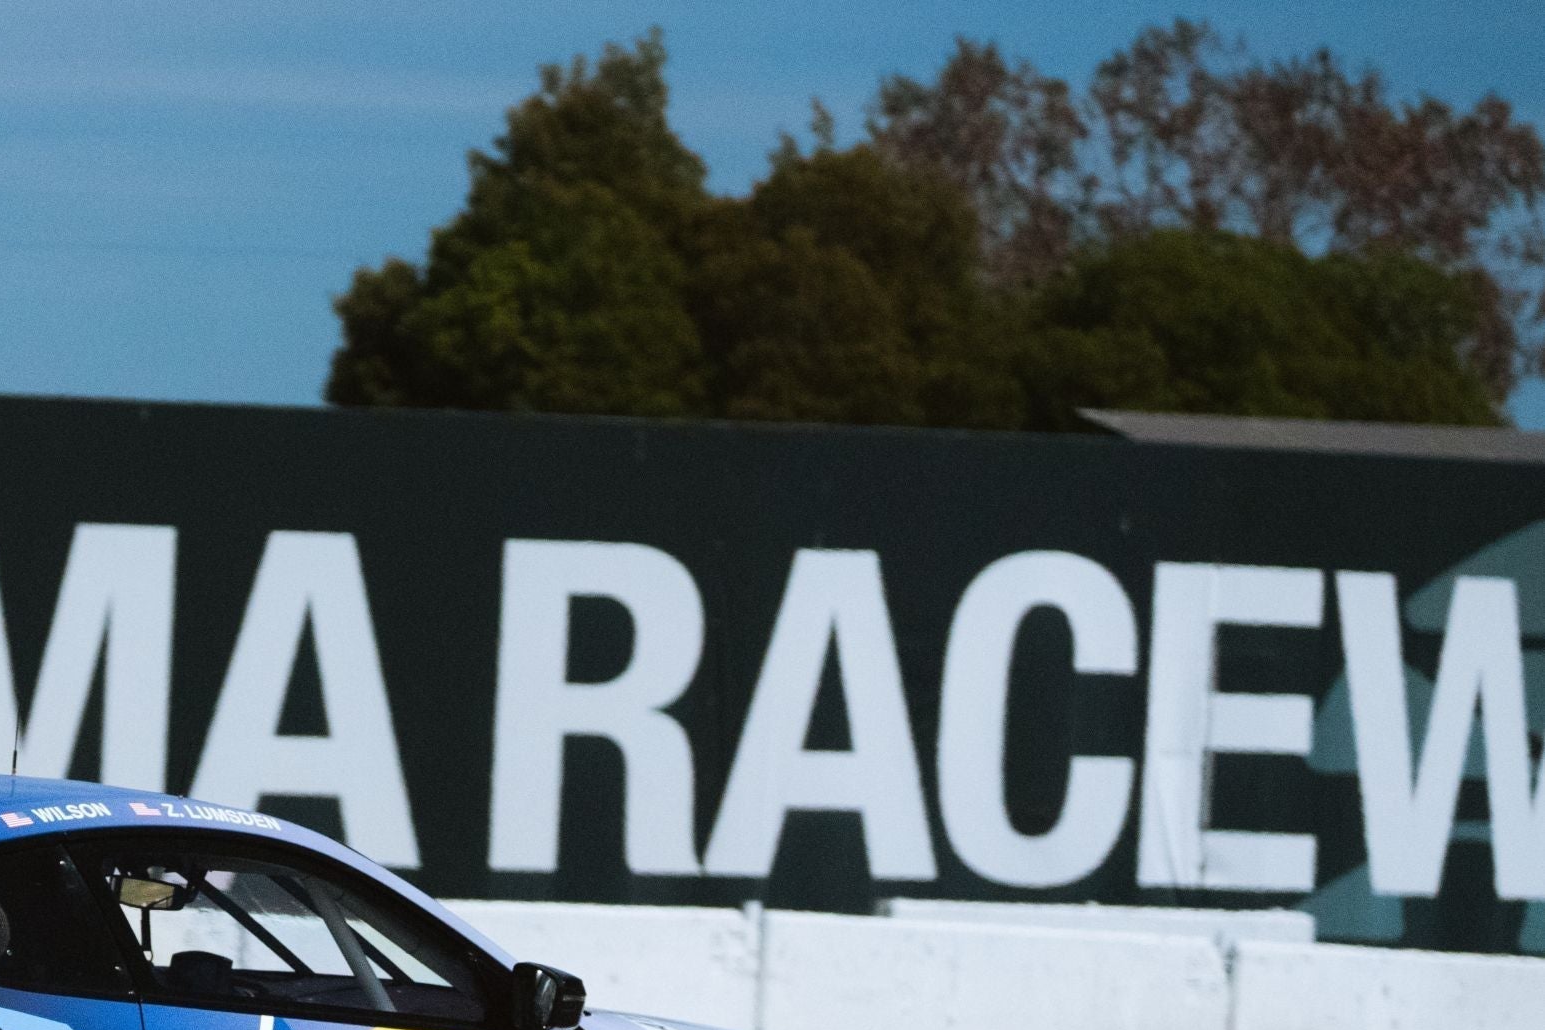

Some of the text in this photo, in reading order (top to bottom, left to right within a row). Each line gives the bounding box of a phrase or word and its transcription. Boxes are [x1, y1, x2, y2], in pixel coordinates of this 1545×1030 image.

[487, 537, 1545, 900] RACEW
[31, 802, 112, 823] WILSON
[161, 803, 282, 831] Z. LUMSDEN
